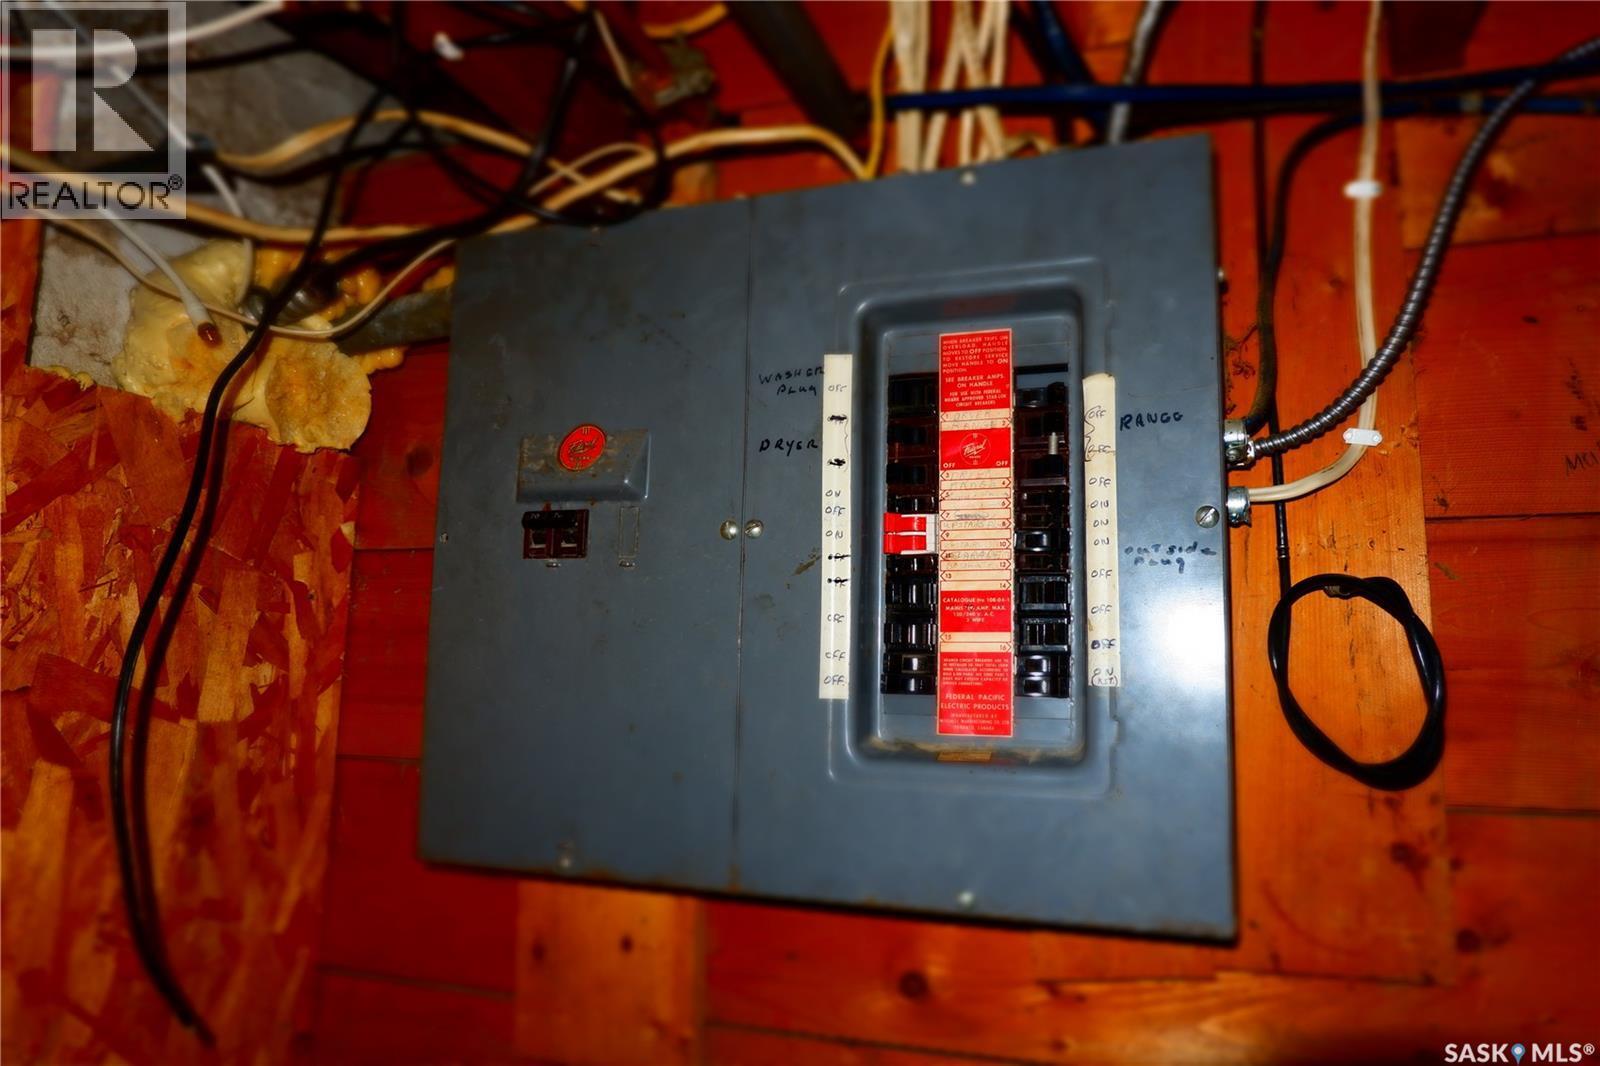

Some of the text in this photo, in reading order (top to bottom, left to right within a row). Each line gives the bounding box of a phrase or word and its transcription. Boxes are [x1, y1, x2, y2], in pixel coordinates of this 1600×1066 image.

[825, 489, 841, 498] ON
[1090, 500, 1109, 509] ON
[1093, 518, 1109, 527] ON
[825, 530, 843, 539] ON
[1094, 537, 1110, 546] ON
[1091, 569, 1112, 579] OFF
